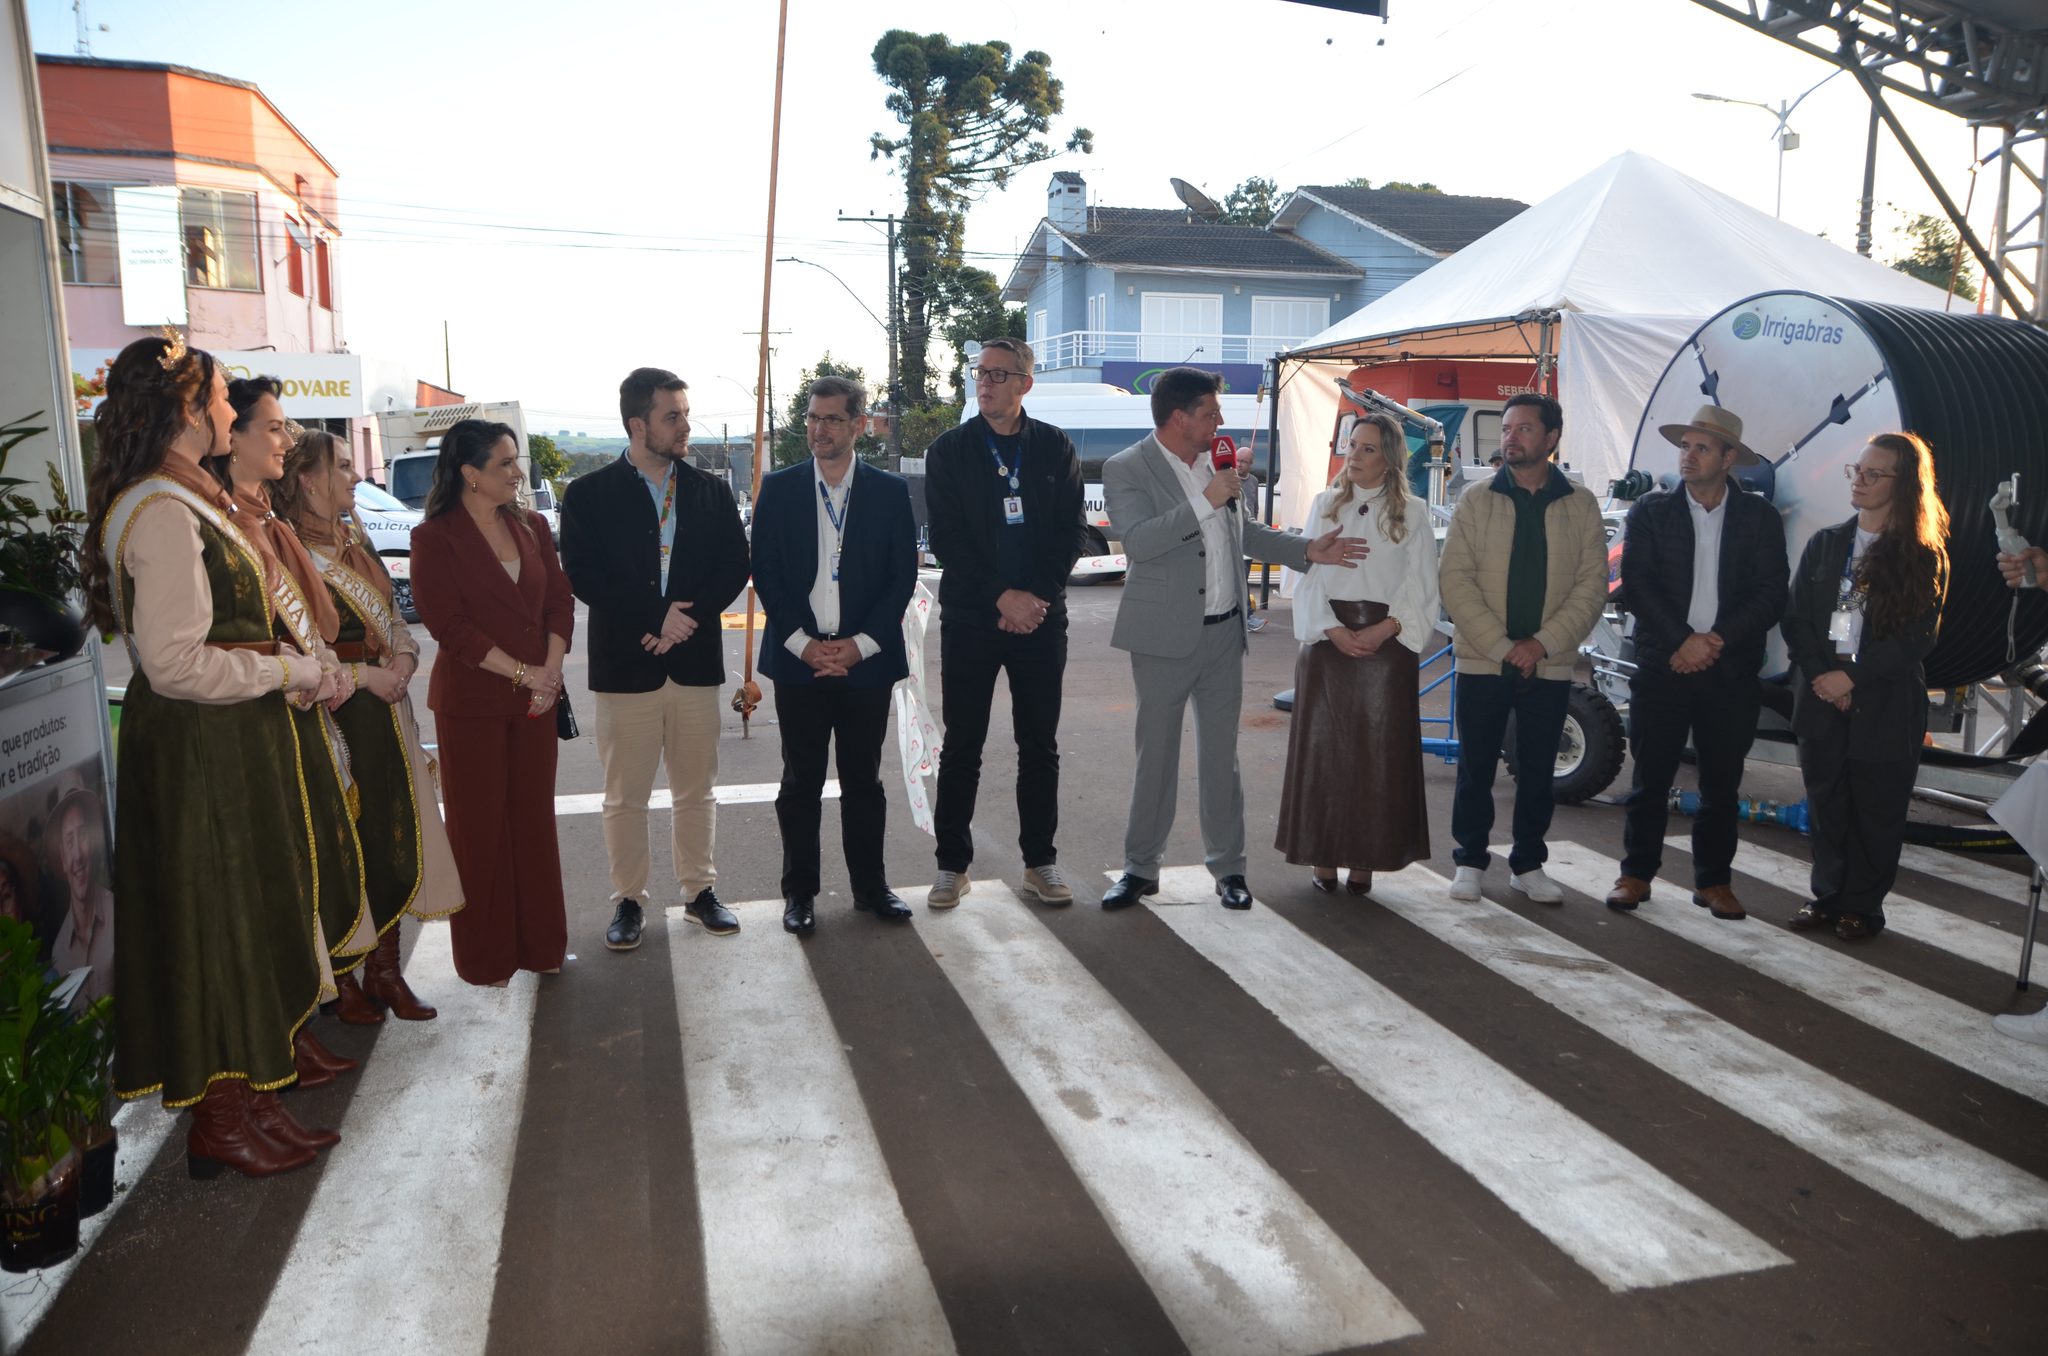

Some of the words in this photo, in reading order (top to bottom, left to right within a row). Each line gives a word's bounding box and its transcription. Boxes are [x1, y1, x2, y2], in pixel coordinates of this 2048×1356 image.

[1762, 314, 1843, 345] Irrigabras
[1084, 500, 1107, 512] MU
[1, 734, 21, 758] que
[22, 716, 67, 750] produtos:
[8, 768, 16, 784] e
[17, 745, 60, 780] tradição
